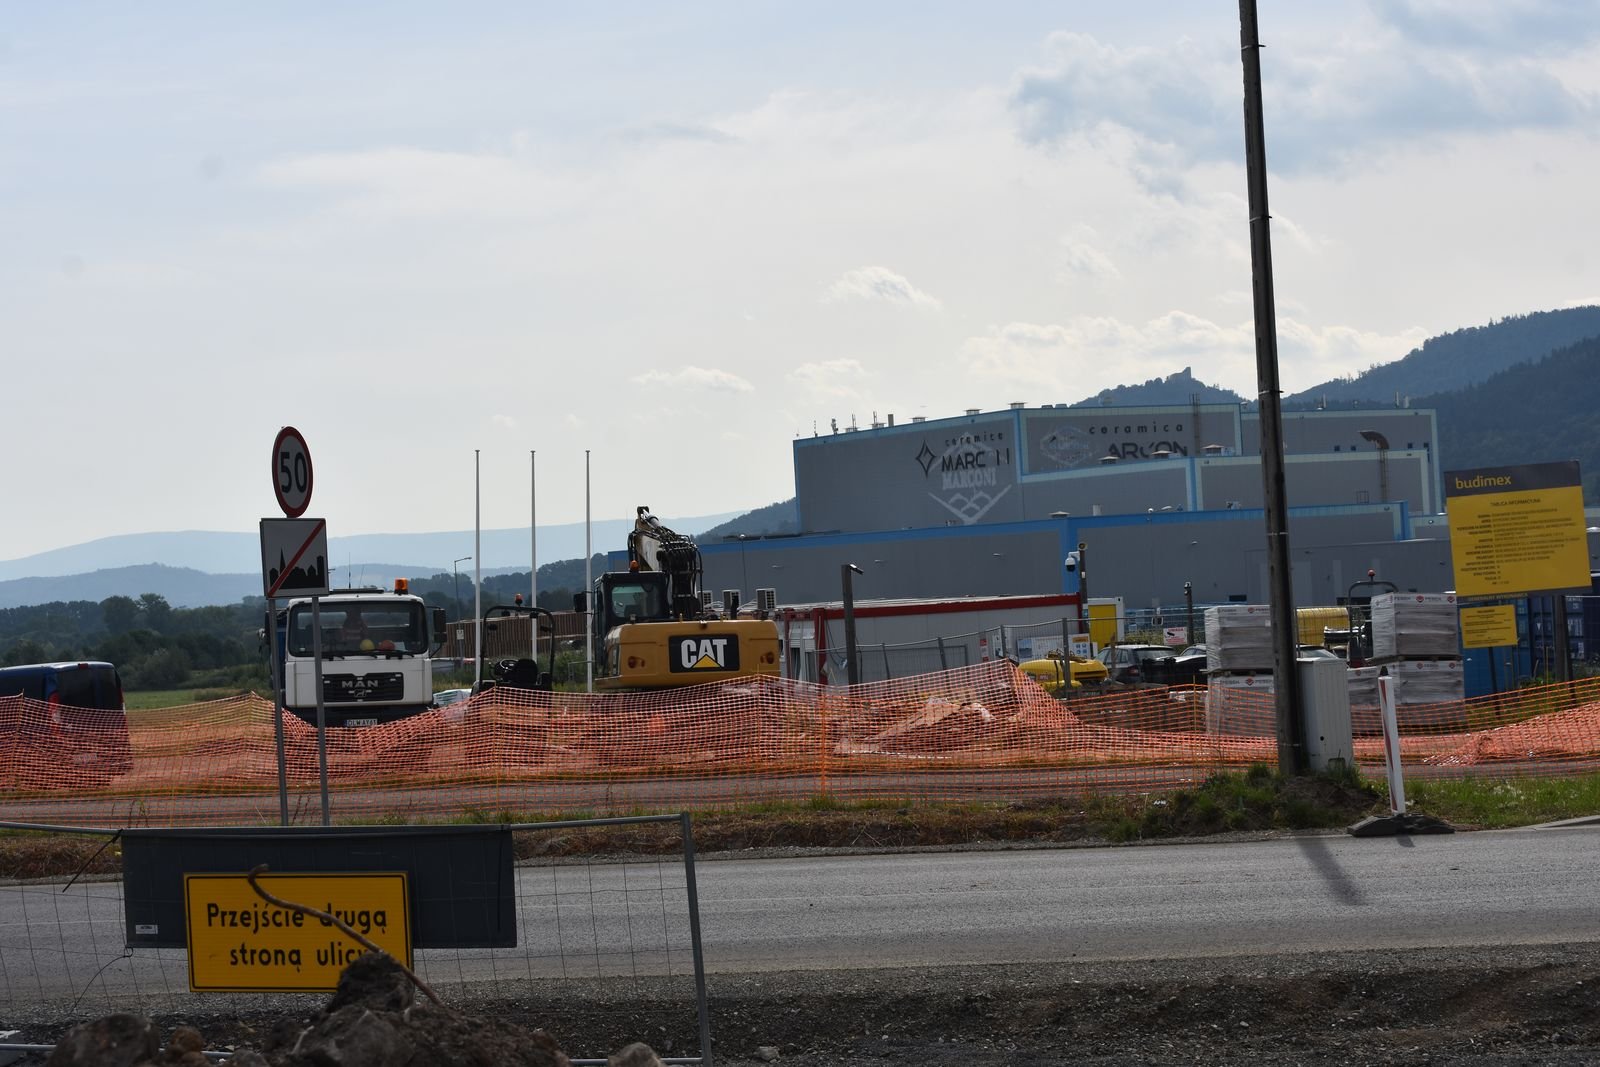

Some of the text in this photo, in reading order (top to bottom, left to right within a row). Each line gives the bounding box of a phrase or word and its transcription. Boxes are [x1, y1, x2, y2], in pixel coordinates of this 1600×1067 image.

[1089, 421, 1183, 434] ceramica
[280, 452, 308, 494] 50
[942, 467, 997, 491] MARCONI
[1455, 474, 1512, 490] budimex
[681, 639, 728, 669] CAT
[341, 680, 379, 689] MAN
[207, 903, 388, 935] Przejście drugą
[230, 942, 303, 973] stroną
